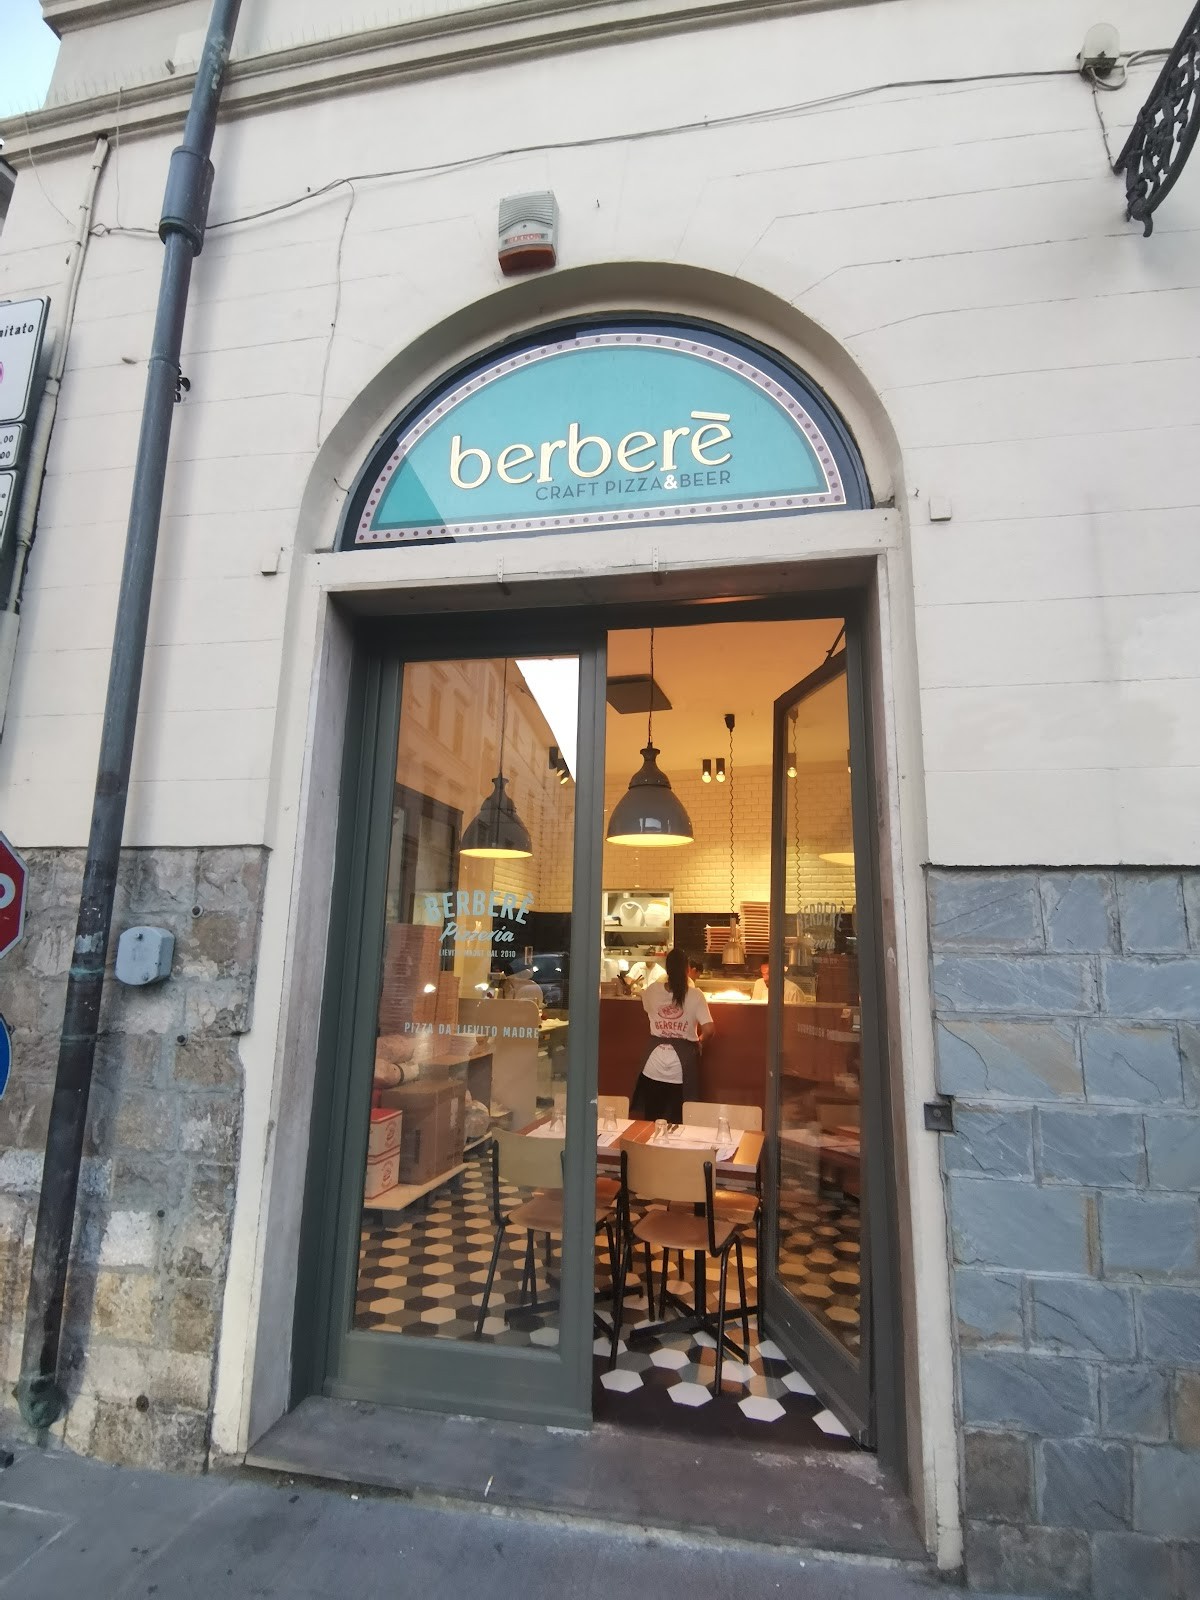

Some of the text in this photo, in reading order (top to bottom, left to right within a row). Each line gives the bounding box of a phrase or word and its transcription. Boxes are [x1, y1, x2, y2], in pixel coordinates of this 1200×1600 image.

[535, 482, 599, 501] CRAFT
[424, 889, 535, 925] BERBERÈ
[500, 950, 516, 959] 2010
[404, 1021, 540, 1039] PIZZA DA LIEVITO MADRE
